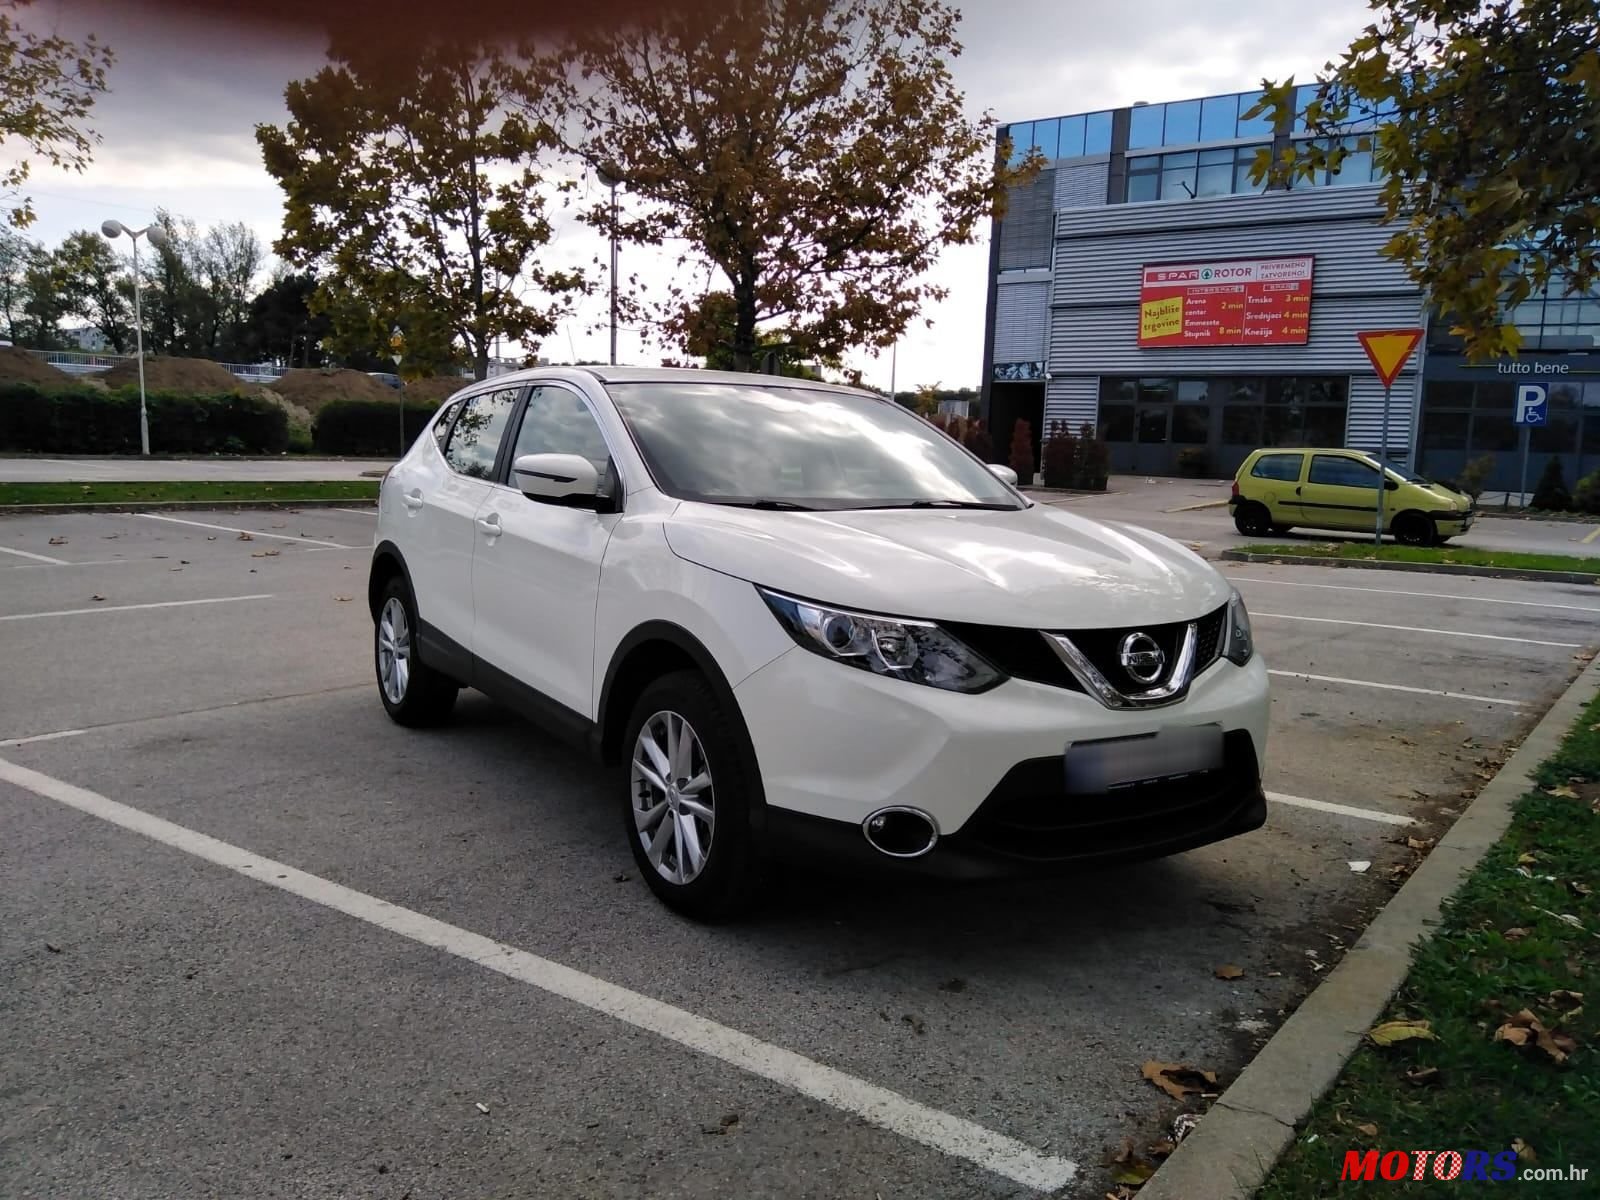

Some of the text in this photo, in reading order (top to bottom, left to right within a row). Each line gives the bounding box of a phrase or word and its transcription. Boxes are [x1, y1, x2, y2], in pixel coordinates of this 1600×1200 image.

[1261, 262, 1306, 270] PRIVREMENO
[1157, 267, 1252, 280] SPAR ROTOR
[1261, 270, 1305, 279] ZATVORENO!
[1248, 295, 1273, 303] Trnsko
[1285, 294, 1309, 302] 3 min
[1221, 301, 1227, 310] 2
[1144, 304, 1180, 320] Najbliže
[1283, 310, 1308, 319] 4 min
[1246, 312, 1282, 322] Srednjaci
[1144, 318, 1180, 332] trgovine
[1184, 329, 1211, 339] Stupnik
[1219, 326, 1242, 335] 8 min
[1282, 326, 1306, 334] 4 min
[1498, 362, 1569, 374] tutto bene
[1516, 385, 1546, 423] P
